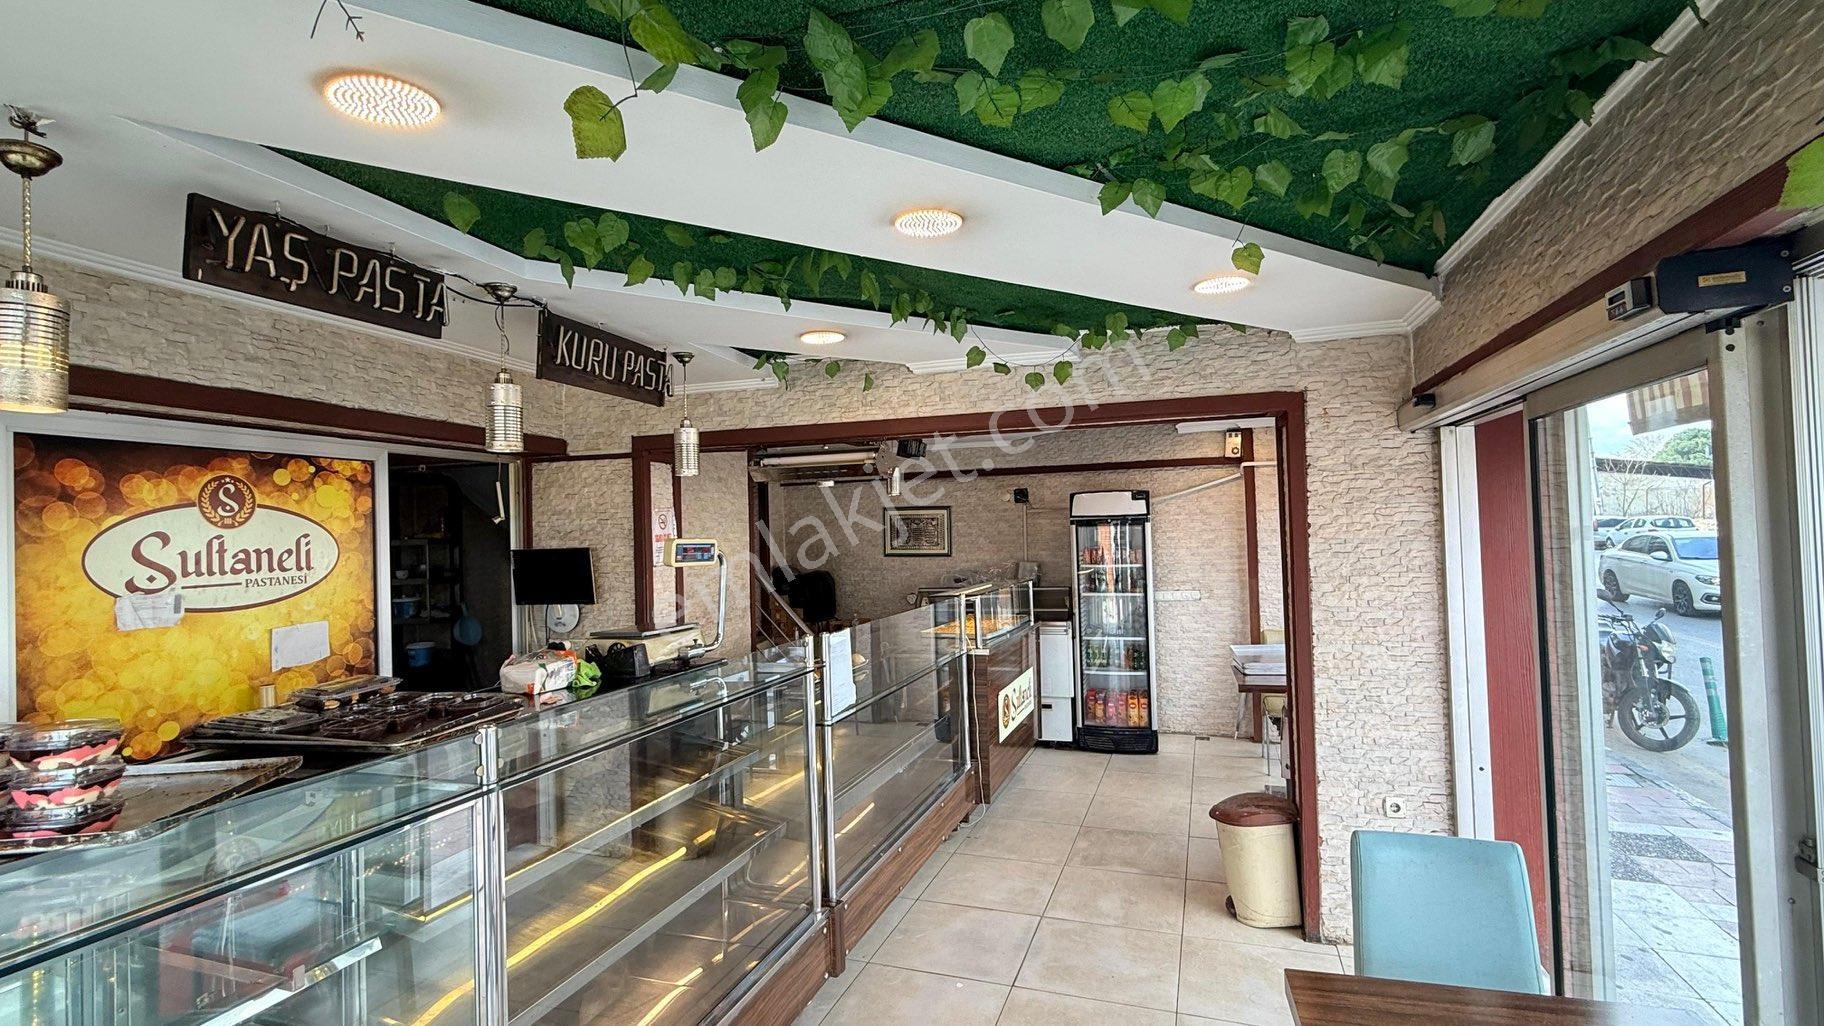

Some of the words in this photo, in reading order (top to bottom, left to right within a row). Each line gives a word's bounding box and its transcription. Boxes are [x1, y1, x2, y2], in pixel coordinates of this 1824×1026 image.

[211, 208, 310, 292] YAŞ
[328, 248, 450, 326] PASTA
[555, 325, 618, 381] KURU
[621, 349, 674, 398] PASTA
[124, 530, 315, 595] Sultaneli
[244, 572, 308, 588] PASTANESİ
